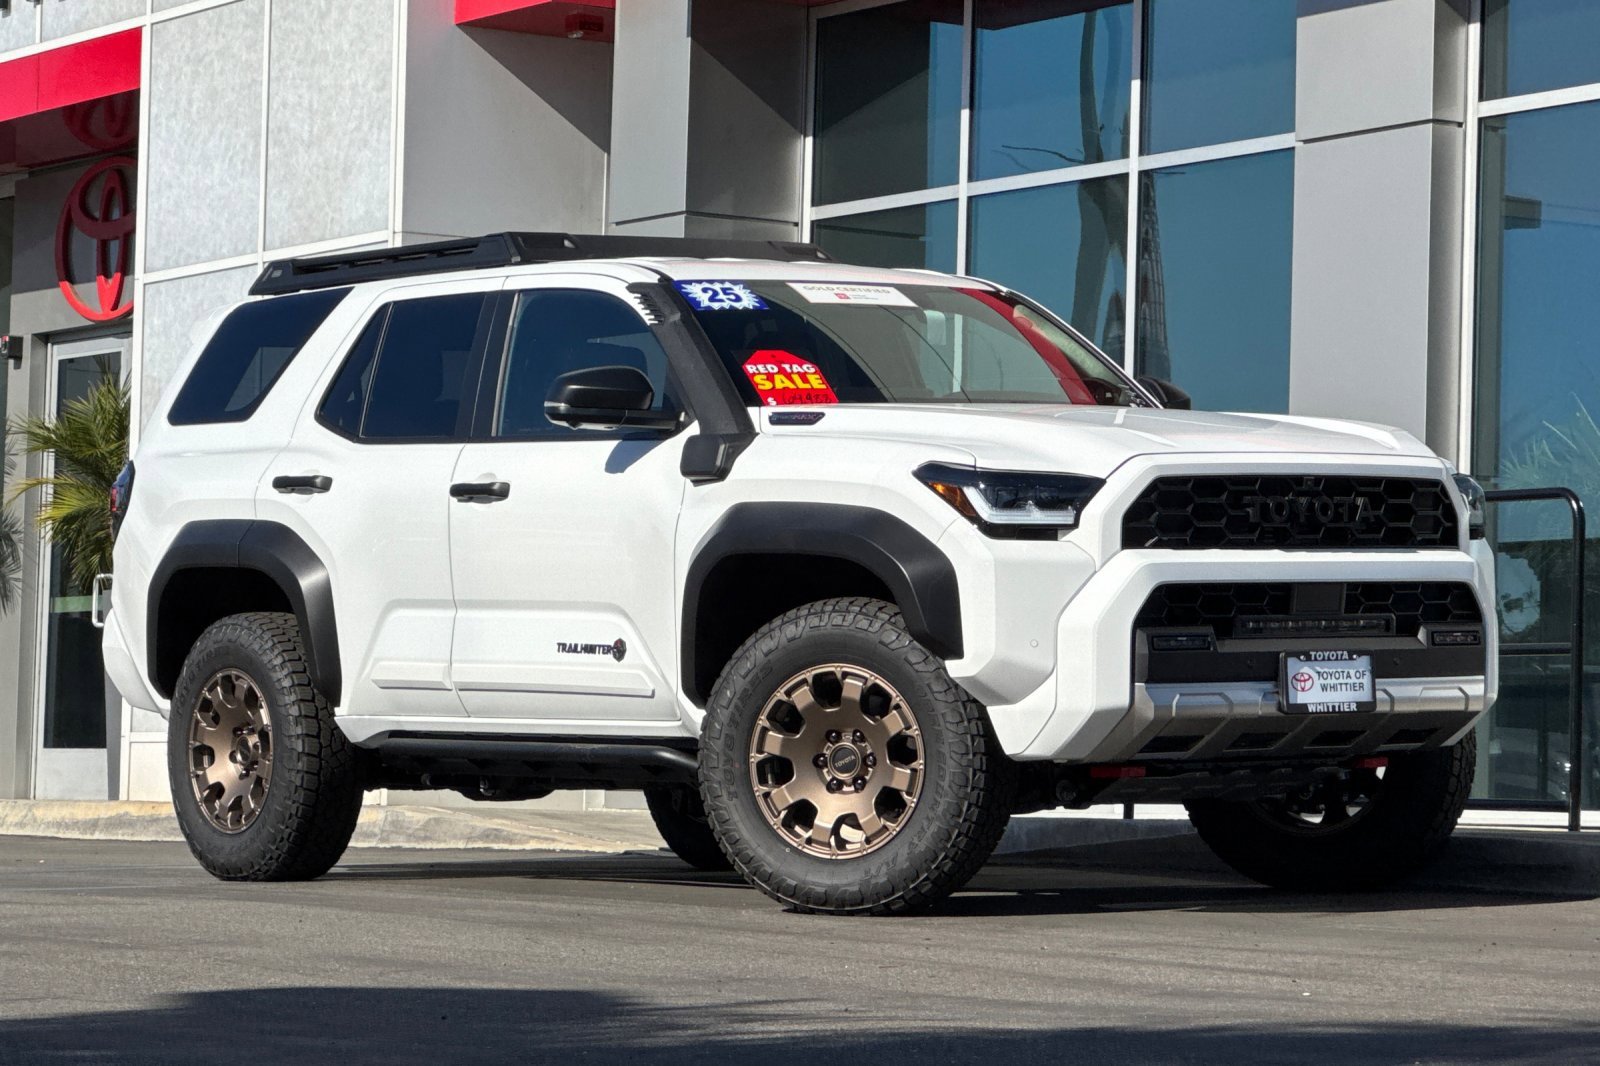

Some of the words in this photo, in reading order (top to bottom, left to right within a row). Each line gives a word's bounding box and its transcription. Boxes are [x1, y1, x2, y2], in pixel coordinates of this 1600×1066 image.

[701, 287, 743, 303] 25
[745, 364, 779, 374] RED
[781, 363, 816, 373] TAG
[753, 374, 827, 390] SALE
[1243, 496, 1375, 522] TOYOTA
[557, 642, 614, 655] TRAILHUNTER
[1310, 651, 1349, 661] TOYOTA
[1316, 670, 1352, 680] TOYOTA
[1354, 670, 1366, 680] OF
[1320, 682, 1365, 692] WHITTIER
[1307, 702, 1357, 713] WHITTIER
[834, 754, 856, 768] TOYOTA
